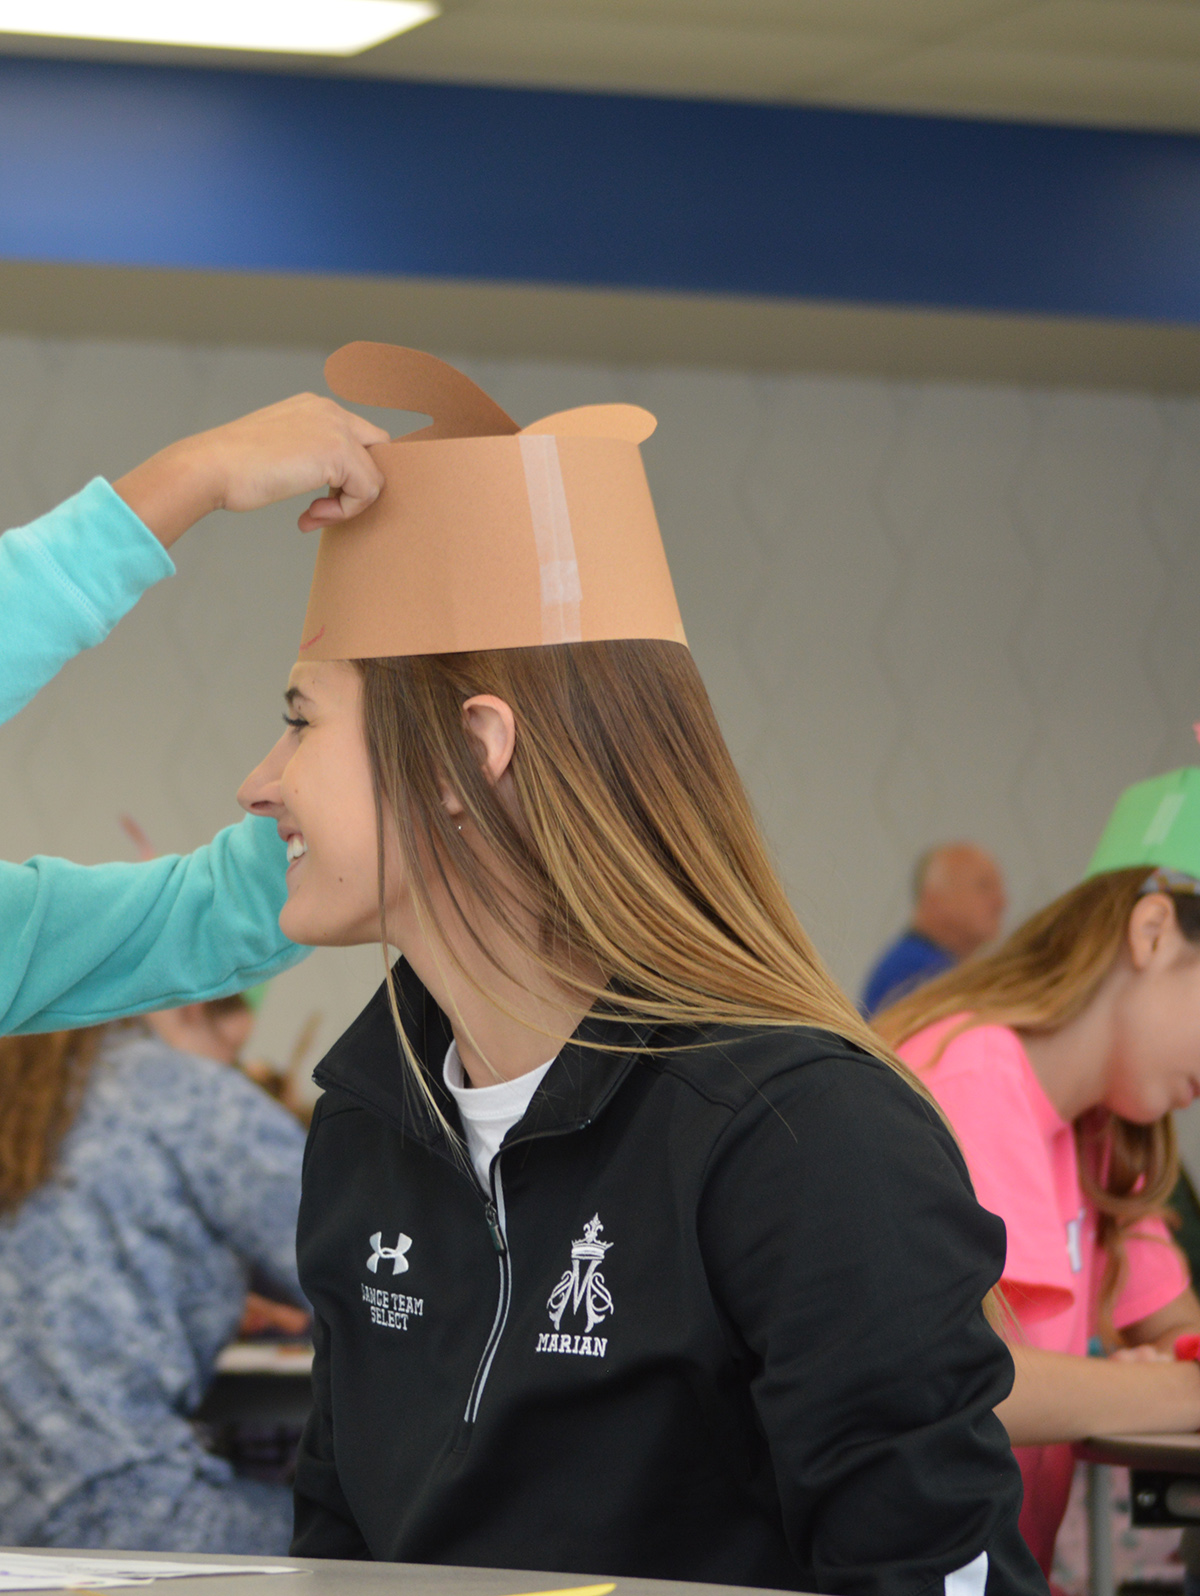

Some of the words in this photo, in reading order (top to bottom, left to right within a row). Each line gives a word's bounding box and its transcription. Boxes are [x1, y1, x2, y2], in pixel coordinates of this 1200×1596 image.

[391, 1293, 424, 1316] TEAM
[370, 1305, 409, 1331] SELECT
[535, 1333, 608, 1357] MARIAN
